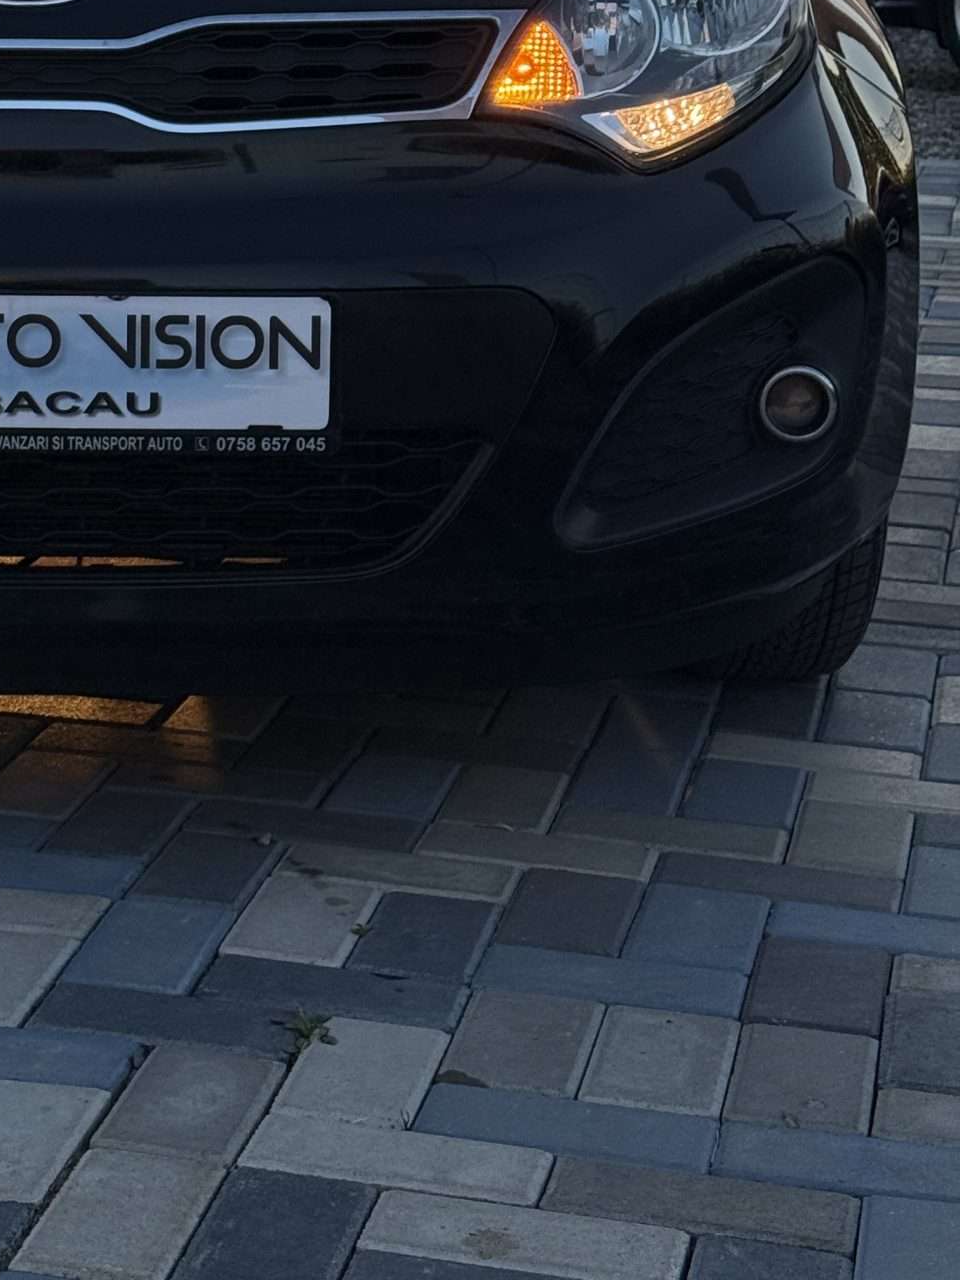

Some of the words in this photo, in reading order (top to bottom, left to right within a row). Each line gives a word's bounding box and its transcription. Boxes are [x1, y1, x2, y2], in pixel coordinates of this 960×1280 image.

[79, 314, 321, 370] VISION
[52, 435, 64, 450] SI
[67, 435, 143, 451] TRANSPORT
[147, 436, 183, 451] AUTO
[216, 436, 256, 452] 0758
[261, 437, 290, 452] 657
[296, 437, 326, 452] 045
